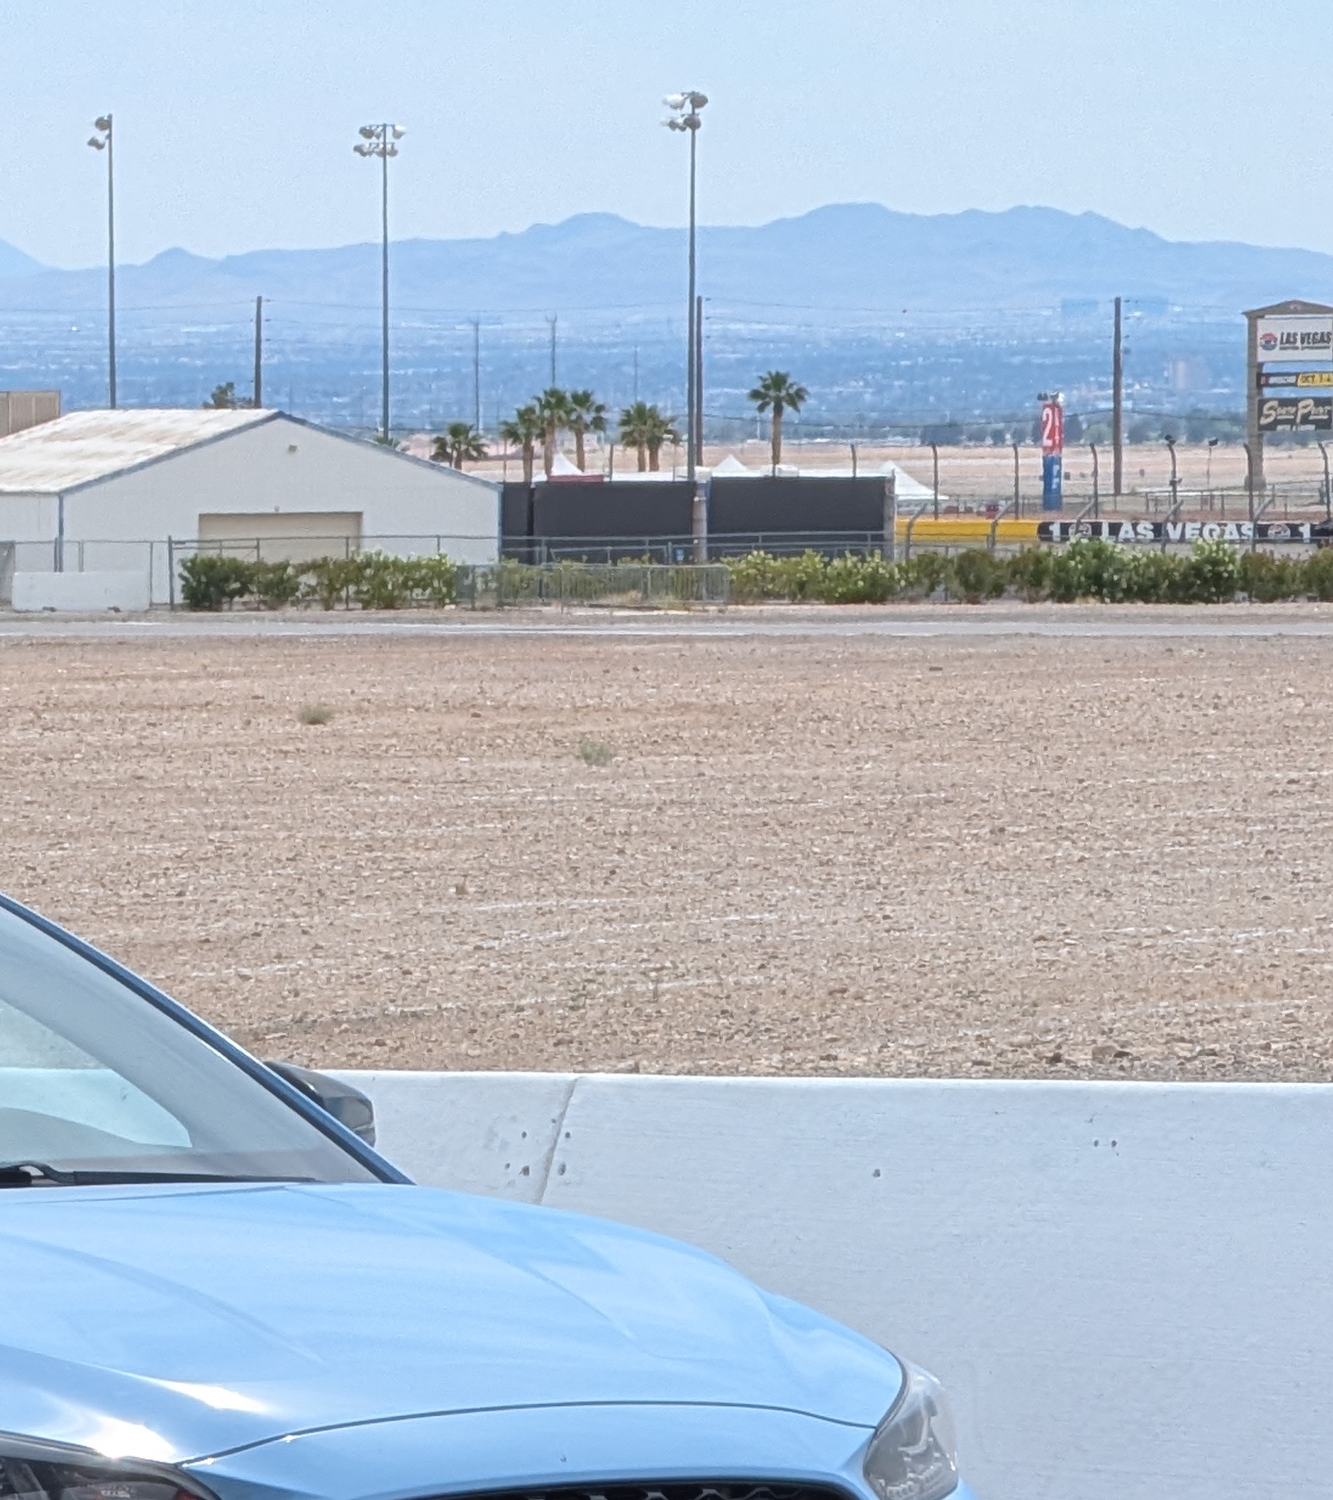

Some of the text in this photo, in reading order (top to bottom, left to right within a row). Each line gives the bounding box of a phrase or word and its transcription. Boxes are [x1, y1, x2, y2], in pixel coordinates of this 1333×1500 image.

[1279, 331, 1332, 346] LAS VEGAS
[1101, 522, 1155, 541] LAS
[1164, 522, 1255, 542] VEGAS
